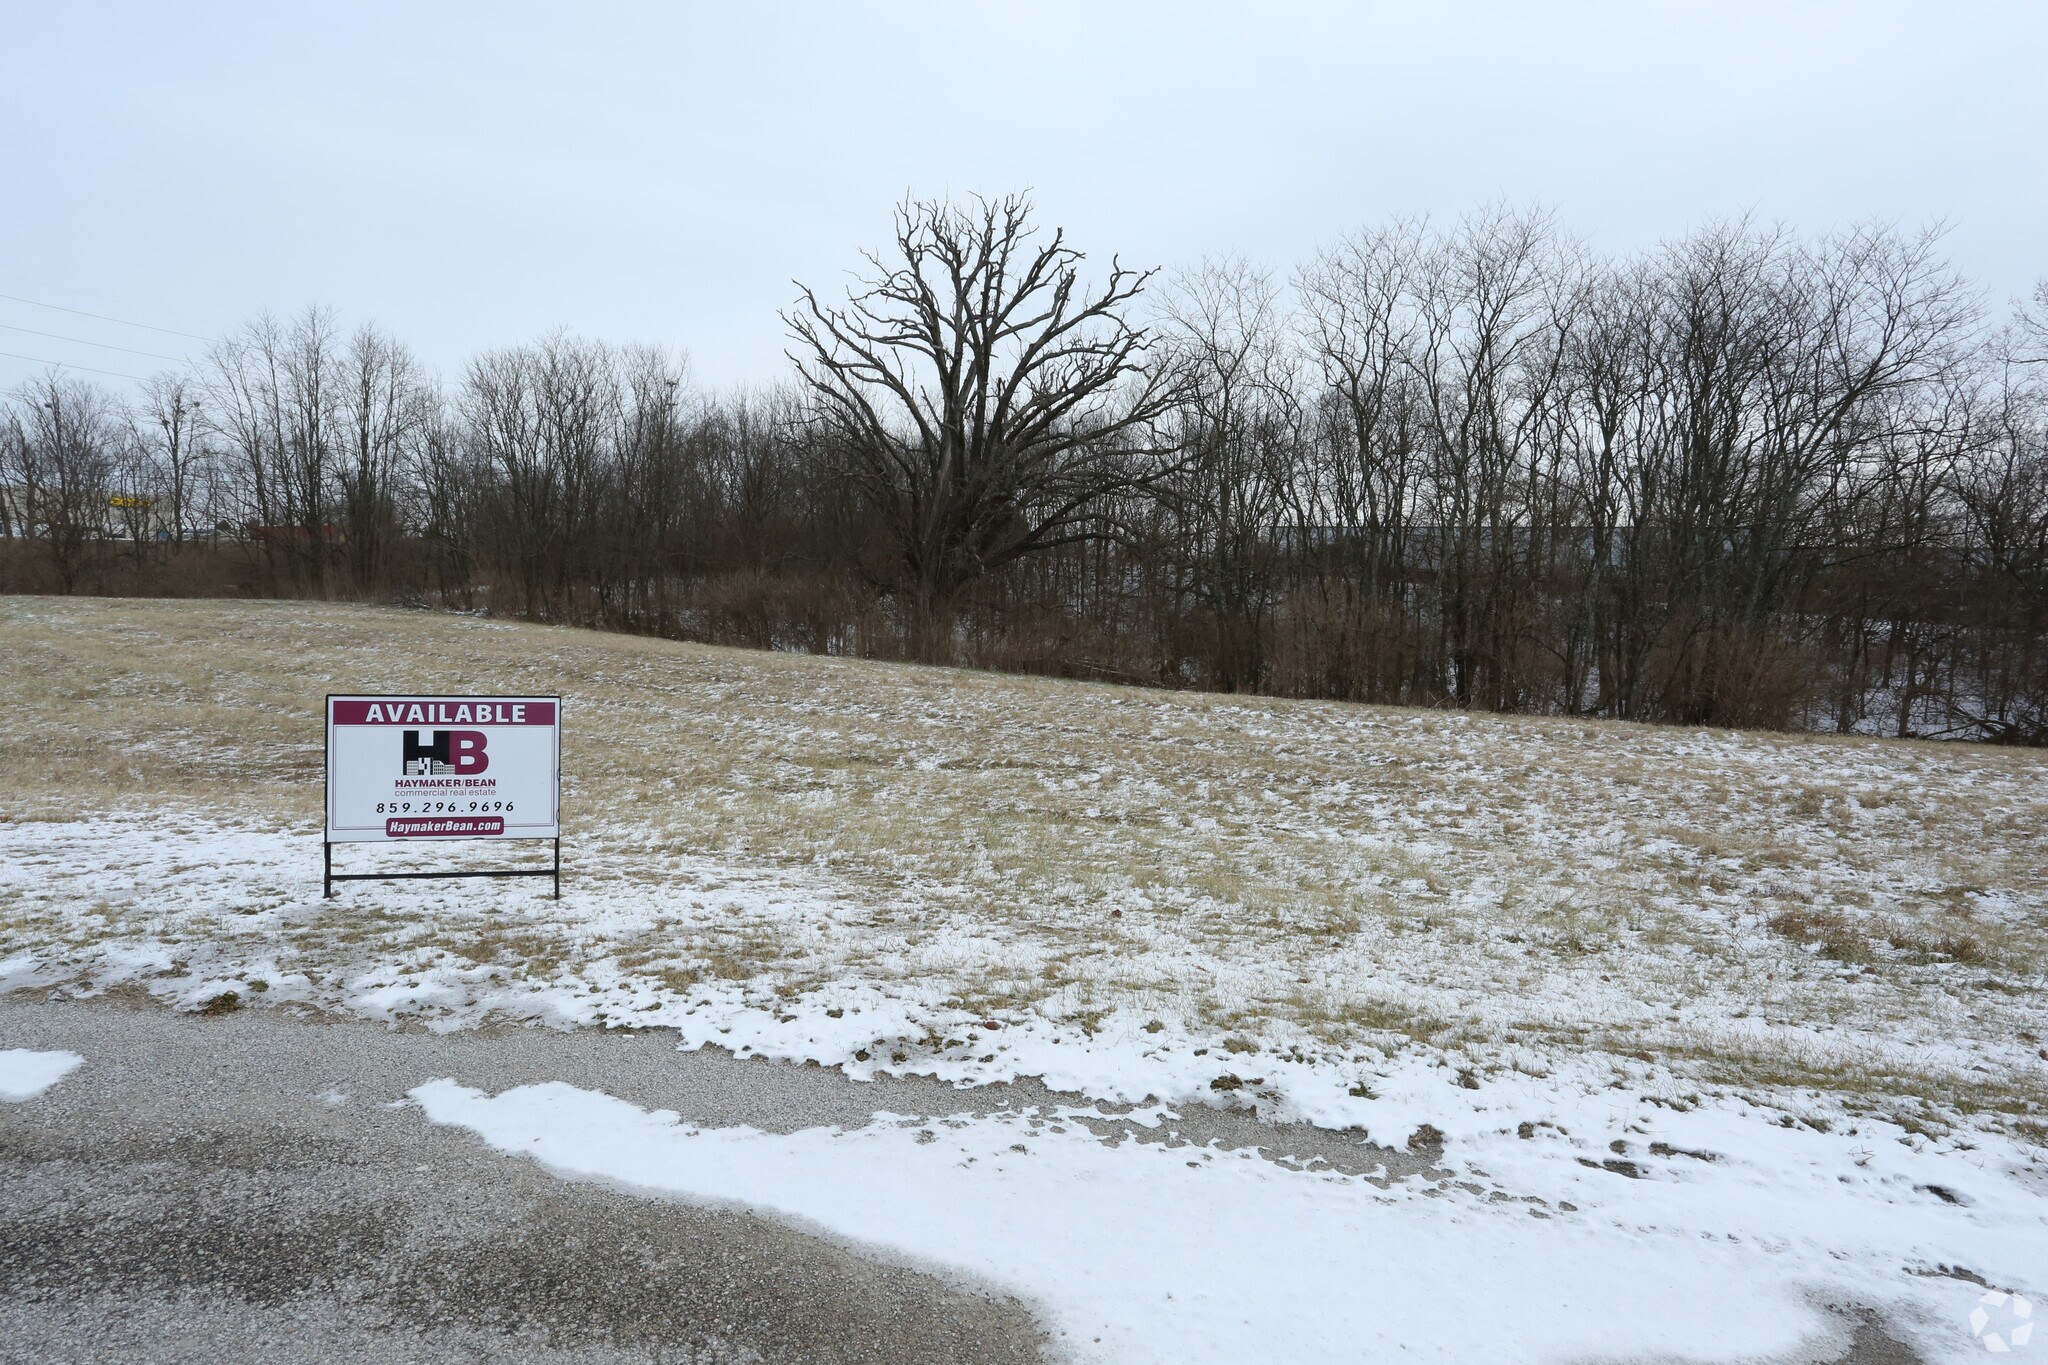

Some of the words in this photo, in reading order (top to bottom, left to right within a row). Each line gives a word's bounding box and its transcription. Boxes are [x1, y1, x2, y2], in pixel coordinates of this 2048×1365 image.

[366, 704, 526, 723] AVAILABLE
[403, 730, 489, 776] HB
[395, 779, 496, 787] HAYMAKER/BEAN
[394, 788, 448, 796] commercial
[450, 788, 467, 796] real
[468, 788, 496, 796] estate
[376, 801, 515, 813] 859.296.9696
[389, 820, 500, 834] HaymakerBean.com
